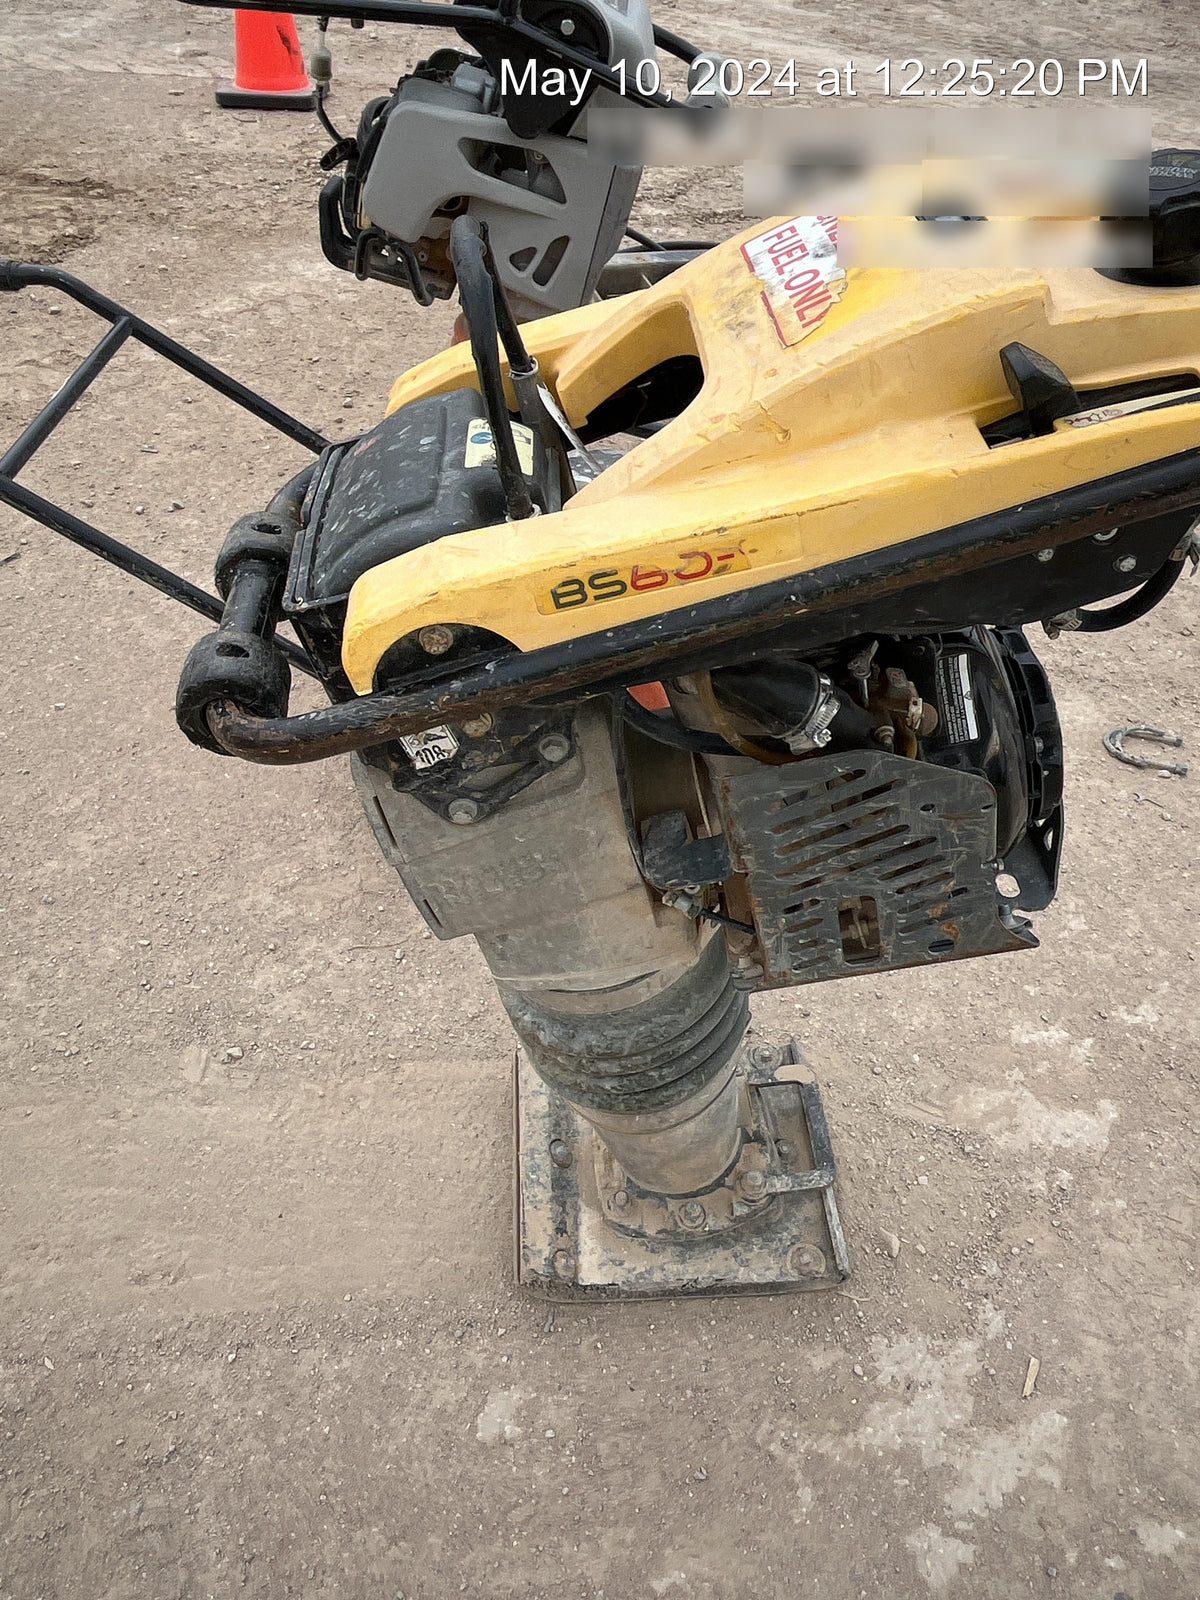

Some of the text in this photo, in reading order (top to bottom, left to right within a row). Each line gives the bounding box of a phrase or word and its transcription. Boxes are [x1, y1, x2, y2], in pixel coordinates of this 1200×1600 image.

[763, 225, 809, 276] FUEL
[784, 269, 833, 329] ONLY
[550, 539, 747, 610] BS60-
